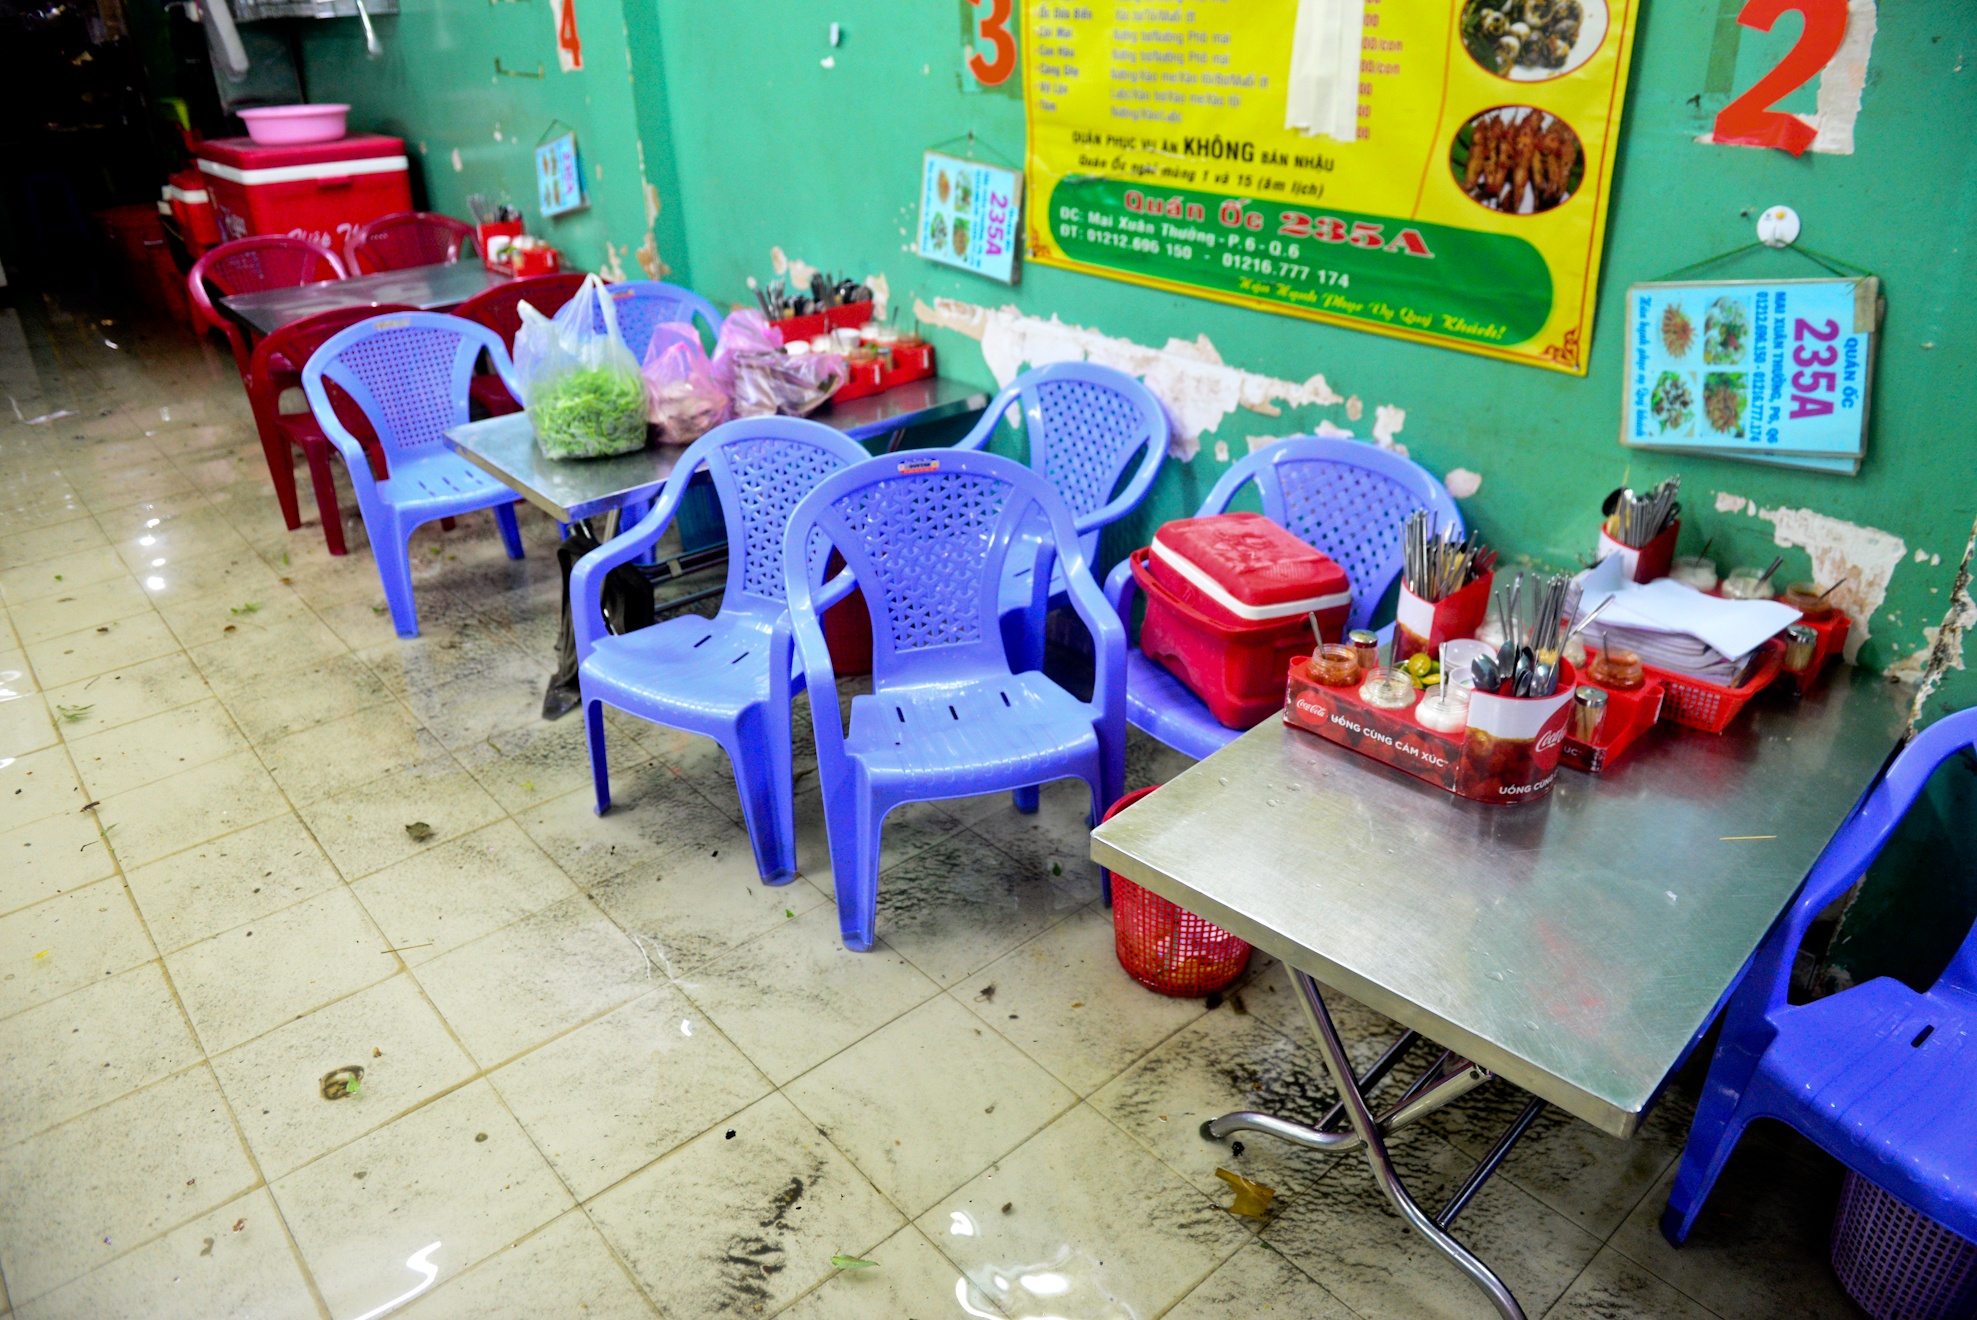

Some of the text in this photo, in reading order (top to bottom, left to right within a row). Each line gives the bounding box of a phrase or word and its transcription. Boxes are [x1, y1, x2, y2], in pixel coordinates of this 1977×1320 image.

[559, 0, 582, 68] 4
[968, 0, 1017, 86] 3
[1712, 0, 1848, 159] 2
[1184, 134, 1254, 162] KHÔNG
[1262, 149, 1288, 167] BÁN
[985, 191, 1008, 255] 235A
[1087, 211, 1113, 228] Mai
[1118, 216, 1155, 235] Xuân
[1124, 190, 1436, 260] Quán Ốc 235A
[1166, 243, 1193, 260] 150
[1222, 252, 1310, 281] 01216.777
[1317, 269, 1349, 289] 174
[1773, 317, 1787, 350] XUÂN
[1774, 291, 1787, 314] MAI
[1789, 318, 1840, 420] 235A
[1841, 337, 1860, 409] QUÁN ỐC
[1498, 784, 1532, 795] UỐNG
